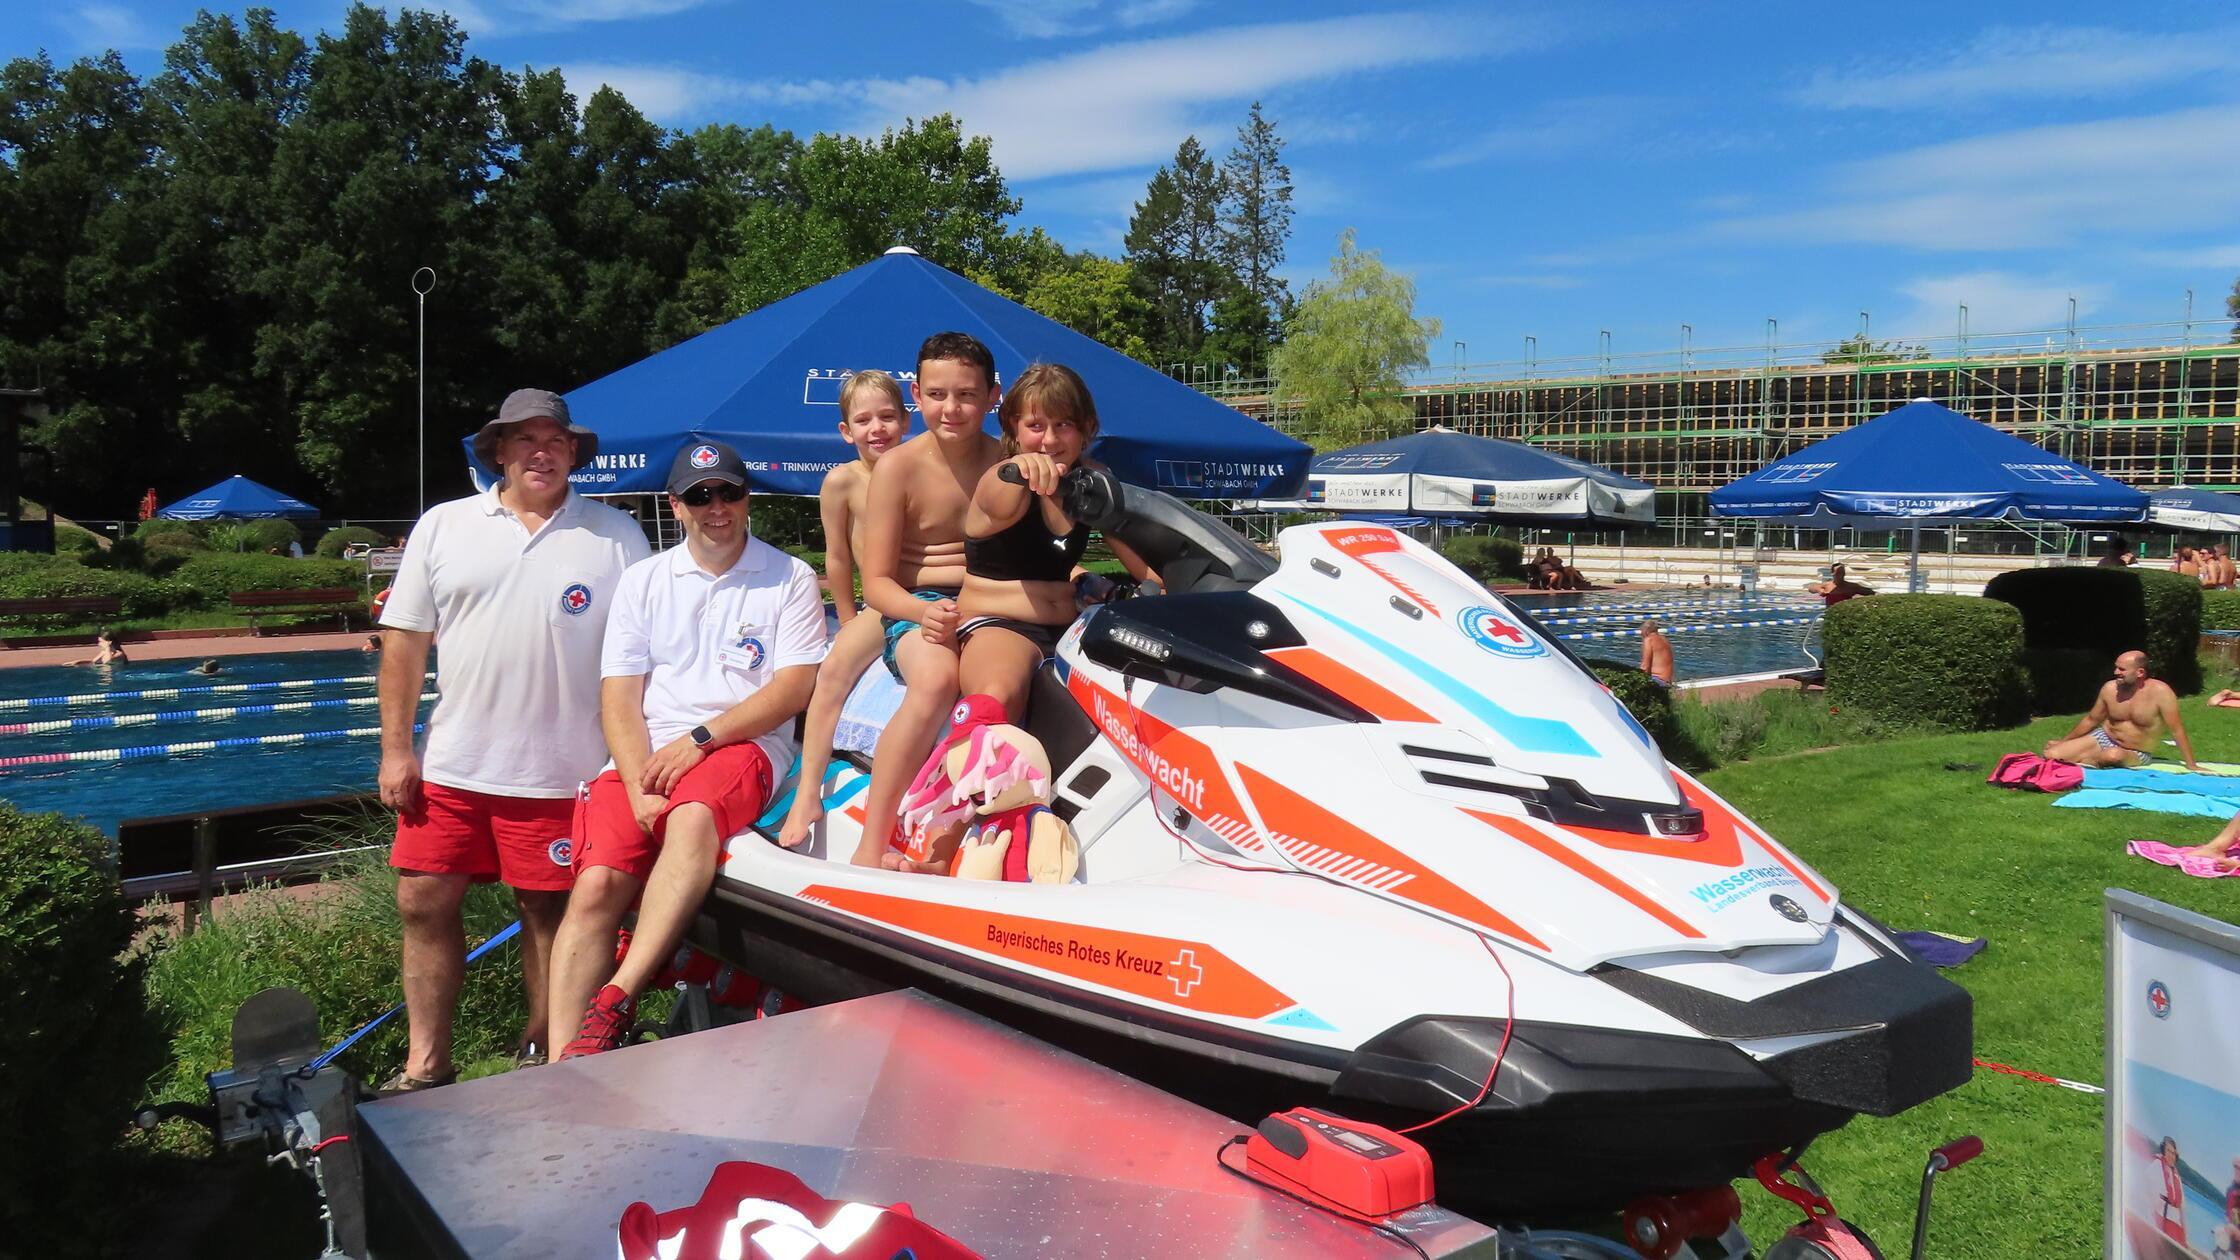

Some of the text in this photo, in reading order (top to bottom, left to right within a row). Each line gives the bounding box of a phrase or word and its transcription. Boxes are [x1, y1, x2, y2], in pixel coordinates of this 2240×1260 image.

[743, 461, 768, 471] RGIE
[1204, 462, 1285, 476] STADTWERKE
[1328, 488, 1402, 497] STADTWERKE
[1499, 492, 1579, 501] STADTWERKE
[1337, 536, 1358, 545] WR
[1093, 689, 1205, 810] Wasserwacht
[1689, 864, 1793, 903] Wasserwacht
[987, 924, 1163, 976] Bayerisches Rotes Kreuz
